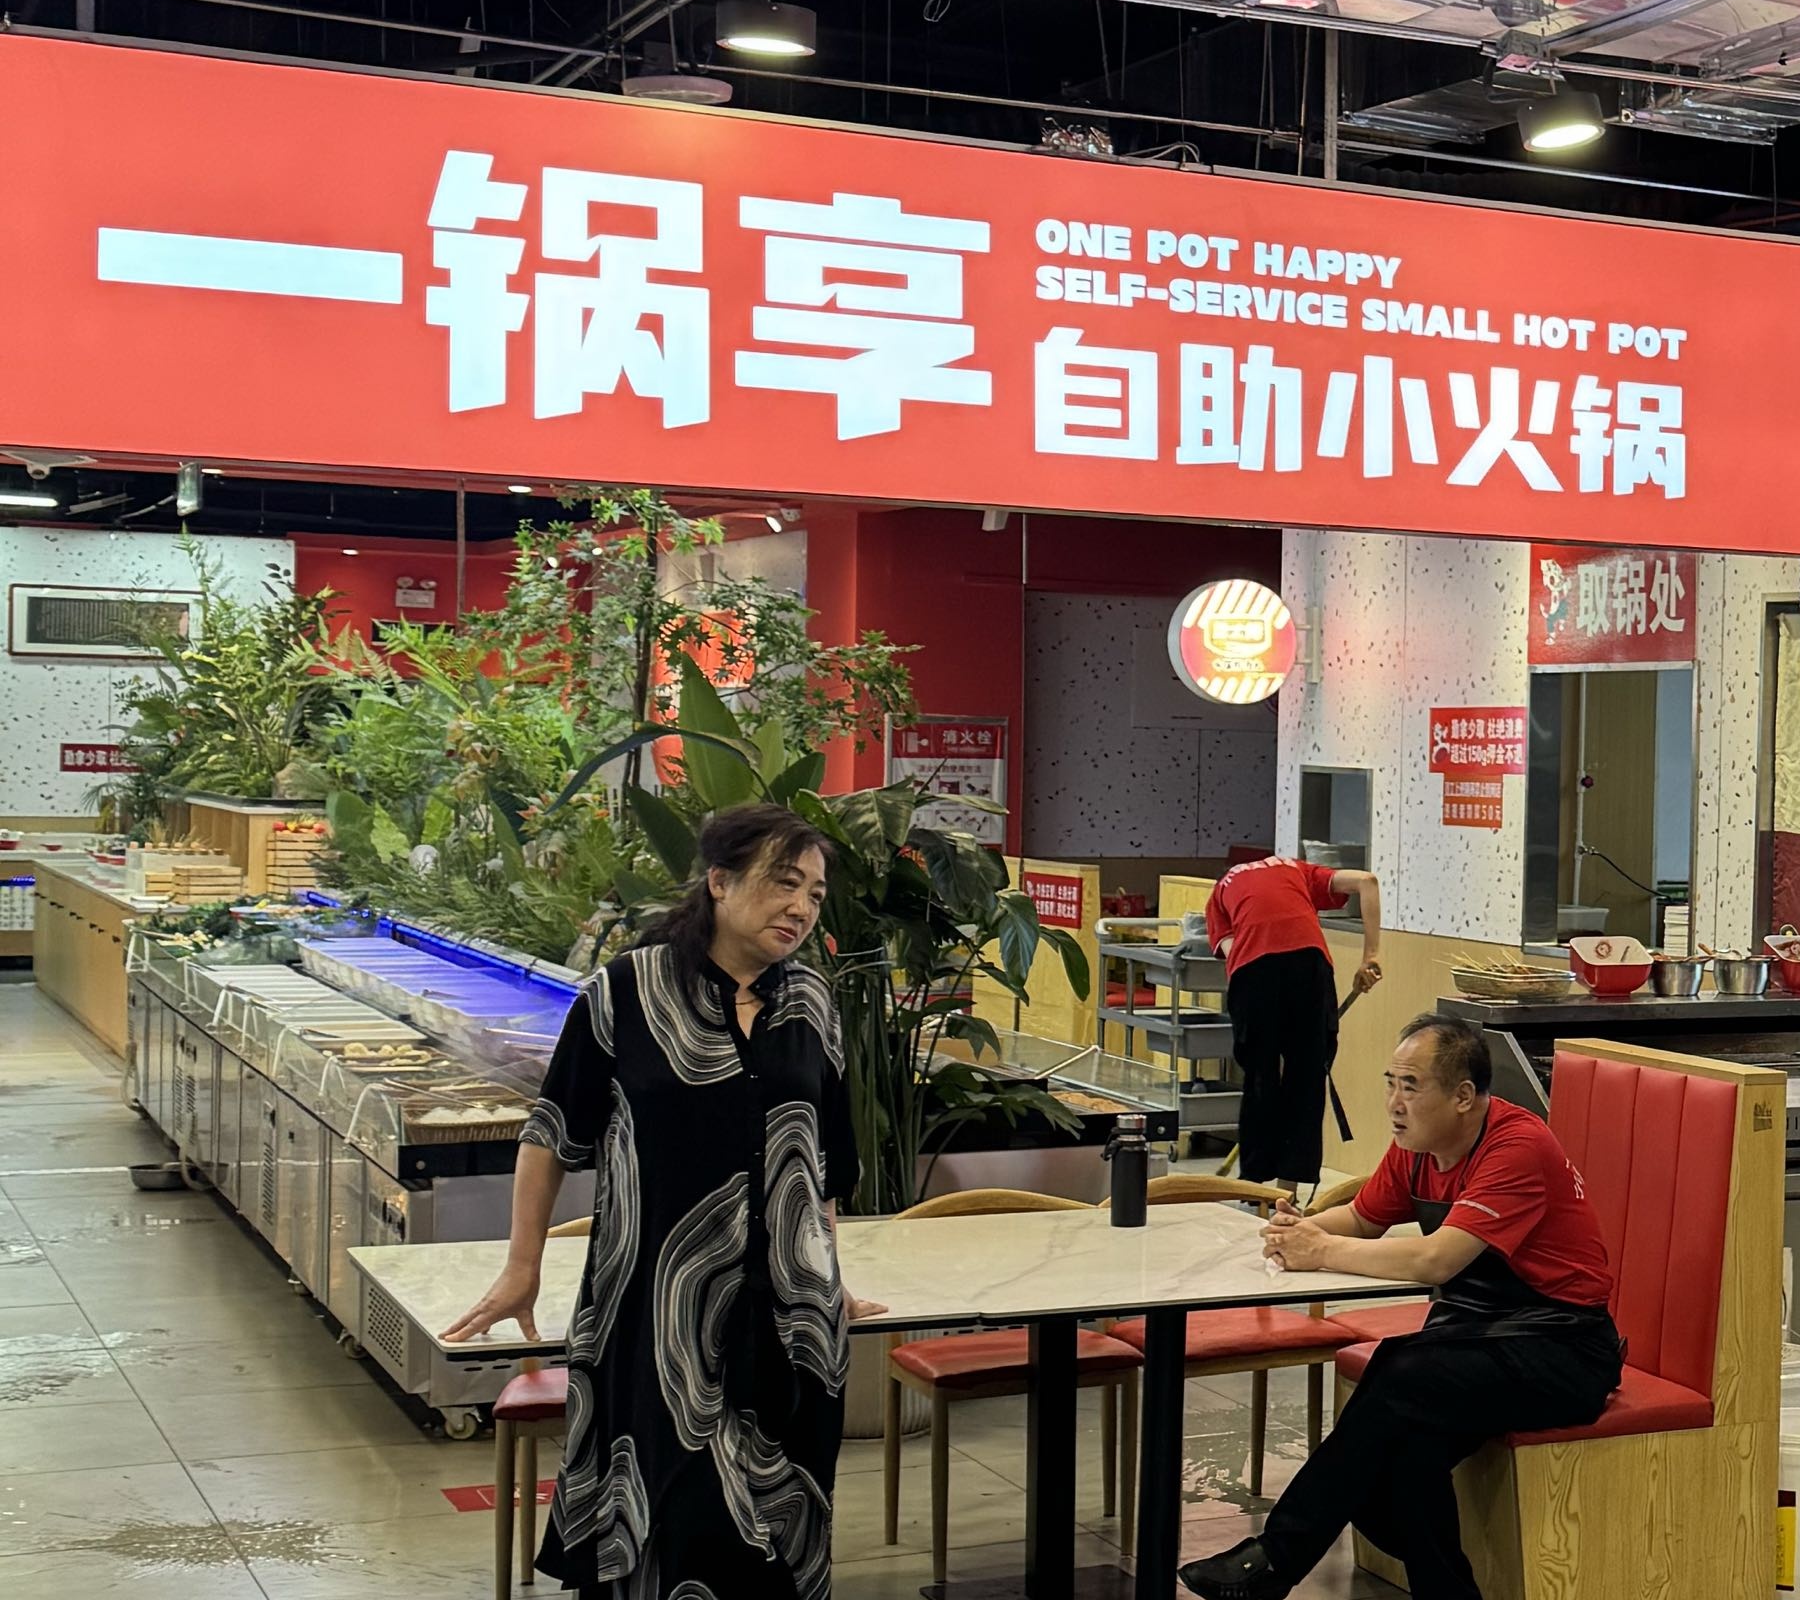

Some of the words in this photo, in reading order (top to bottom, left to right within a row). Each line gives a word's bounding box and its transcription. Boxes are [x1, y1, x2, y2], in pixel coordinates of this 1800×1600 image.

[98, 149, 992, 441] 一锅享
[1035, 218, 1131, 261] ONE
[1147, 229, 1239, 271] POT
[1253, 241, 1401, 289] HAPPY
[1035, 265, 1348, 328] SELF-SERVICE
[1361, 298, 1500, 343] SMALL
[1513, 312, 1595, 351] HOT
[1607, 322, 1687, 360] POT
[1034, 326, 1687, 499] 自助小火锅
[1576, 556, 1685, 636] 取锅处
[943, 730, 992, 745] 消火栓
